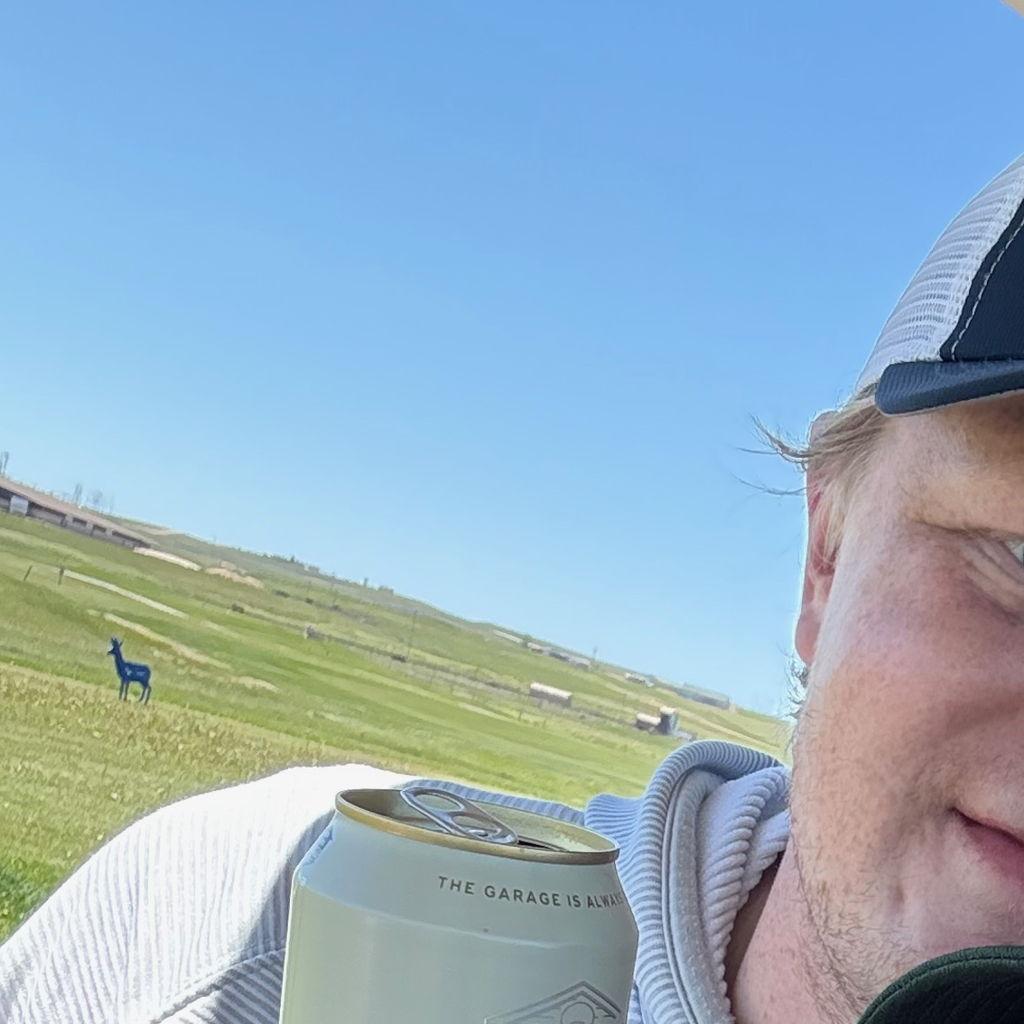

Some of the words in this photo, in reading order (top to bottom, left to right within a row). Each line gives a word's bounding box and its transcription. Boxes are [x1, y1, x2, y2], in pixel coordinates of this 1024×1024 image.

[438, 876, 475, 895] THE
[484, 885, 561, 908] GARAGE
[566, 893, 581, 908] IS
